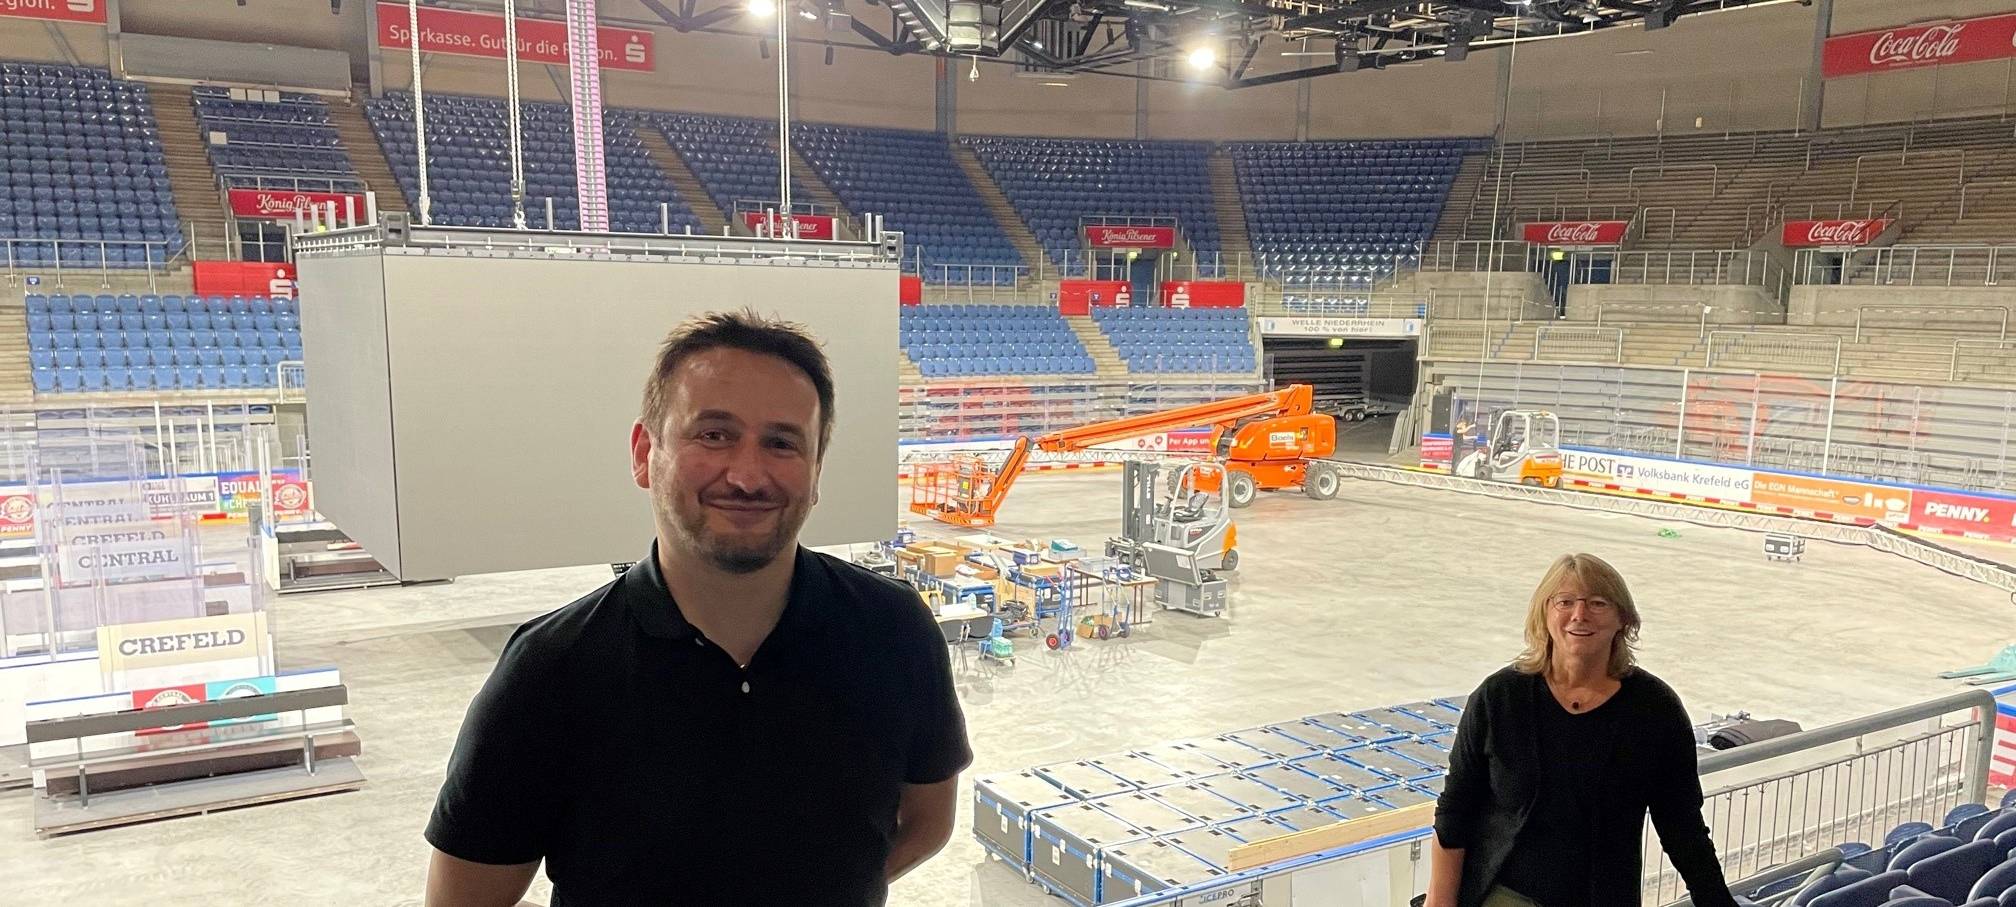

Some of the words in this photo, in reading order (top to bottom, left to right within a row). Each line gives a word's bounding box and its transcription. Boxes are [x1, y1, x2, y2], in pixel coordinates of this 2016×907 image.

[0, 0, 55, 10] gion.
[389, 24, 475, 48] Sprkasse.
[510, 38, 531, 53] ür
[536, 40, 559, 55] die
[1870, 24, 1967, 64] Coca-Cola
[1548, 223, 1601, 241] Coca-Cola
[1291, 319, 1322, 327] WELLE
[1324, 319, 1385, 327] NIEDERRHEIN
[1579, 455, 1616, 474] POST
[1638, 467, 1690, 483] Volksbank
[1692, 473, 1731, 489] Krefeld
[1734, 479, 1750, 490] eG
[118, 629, 245, 656] CREFELD
